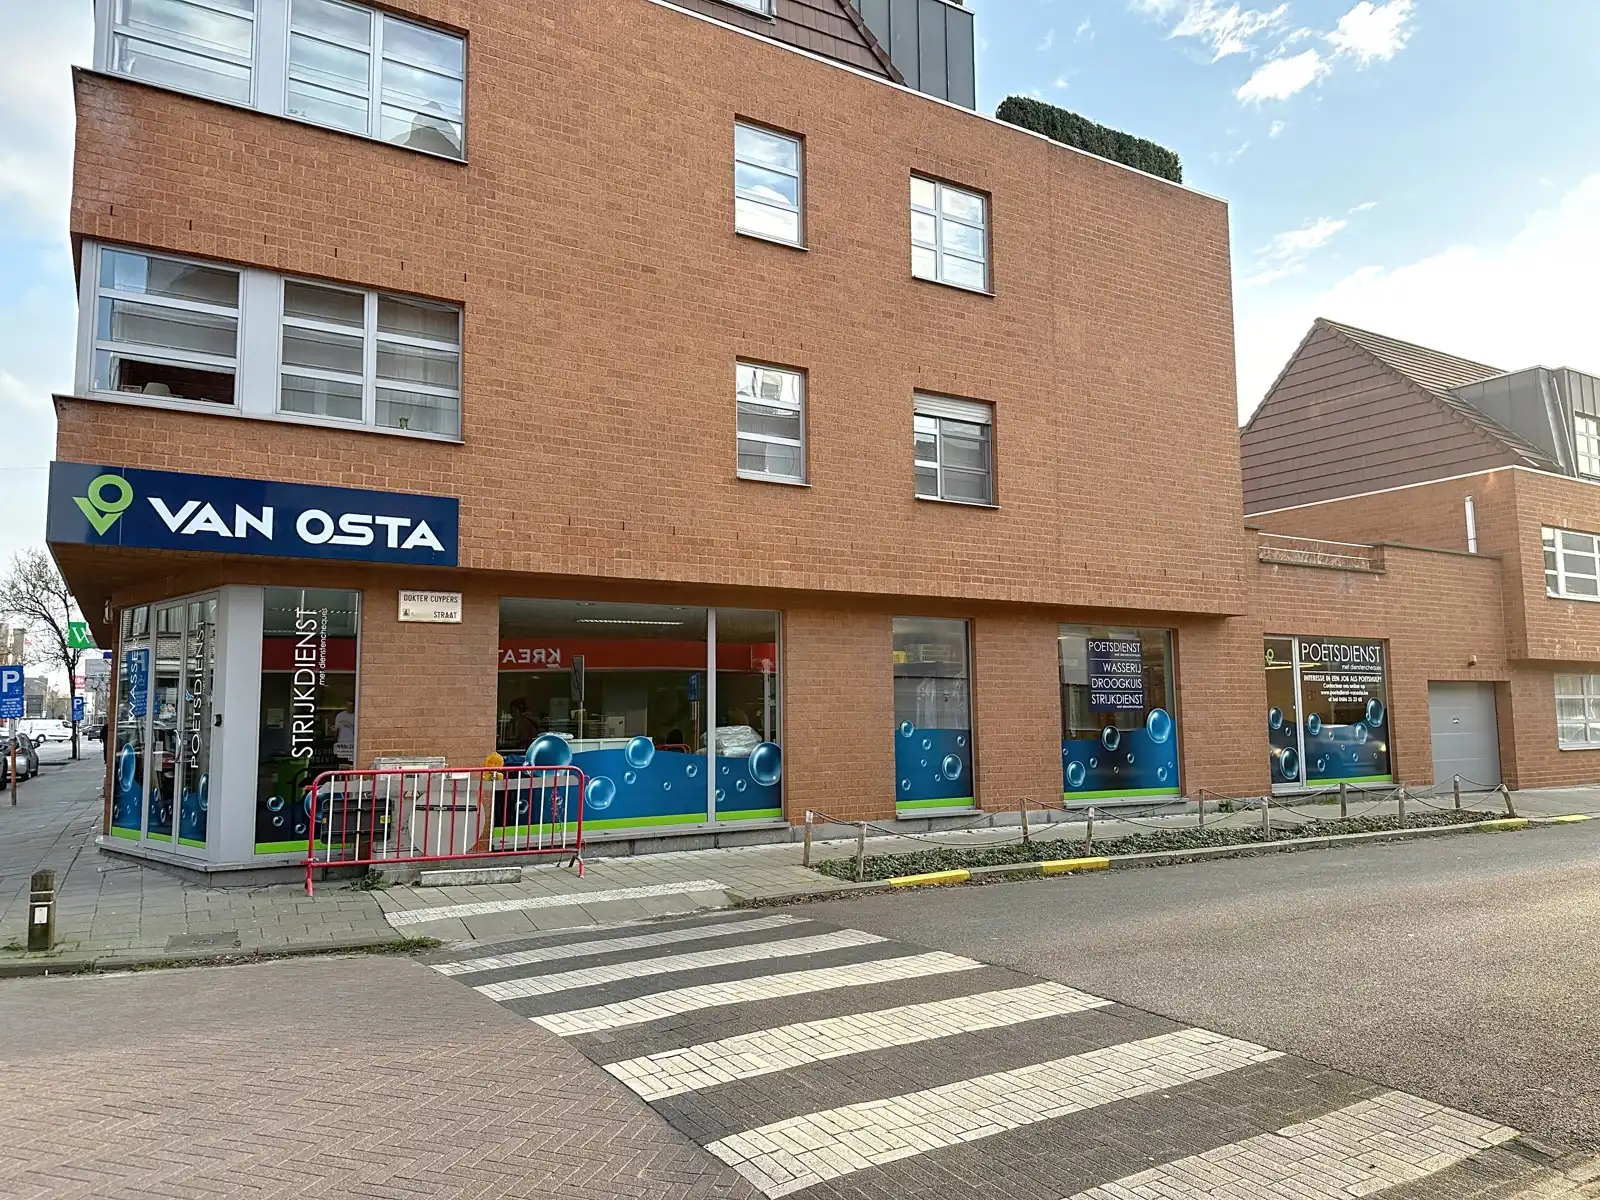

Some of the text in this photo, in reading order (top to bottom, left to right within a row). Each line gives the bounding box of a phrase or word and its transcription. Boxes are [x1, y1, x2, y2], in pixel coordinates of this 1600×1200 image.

[147, 497, 445, 552] VAN OSTA
[403, 593, 458, 603] DOKTER CUYPERS
[433, 611, 458, 619] STRAAT
[1088, 641, 1141, 653] POETSDIENST
[1302, 643, 1381, 663] POETSDIENST
[1102, 662, 1142, 673] WASSERIJ
[3, 670, 20, 692] P
[291, 607, 317, 759] STRIJKDIENST
[1091, 678, 1142, 689] DROOGKUIS
[190, 621, 205, 769] POETSDIENST
[1091, 693, 1143, 705] STRIJKDIENST
